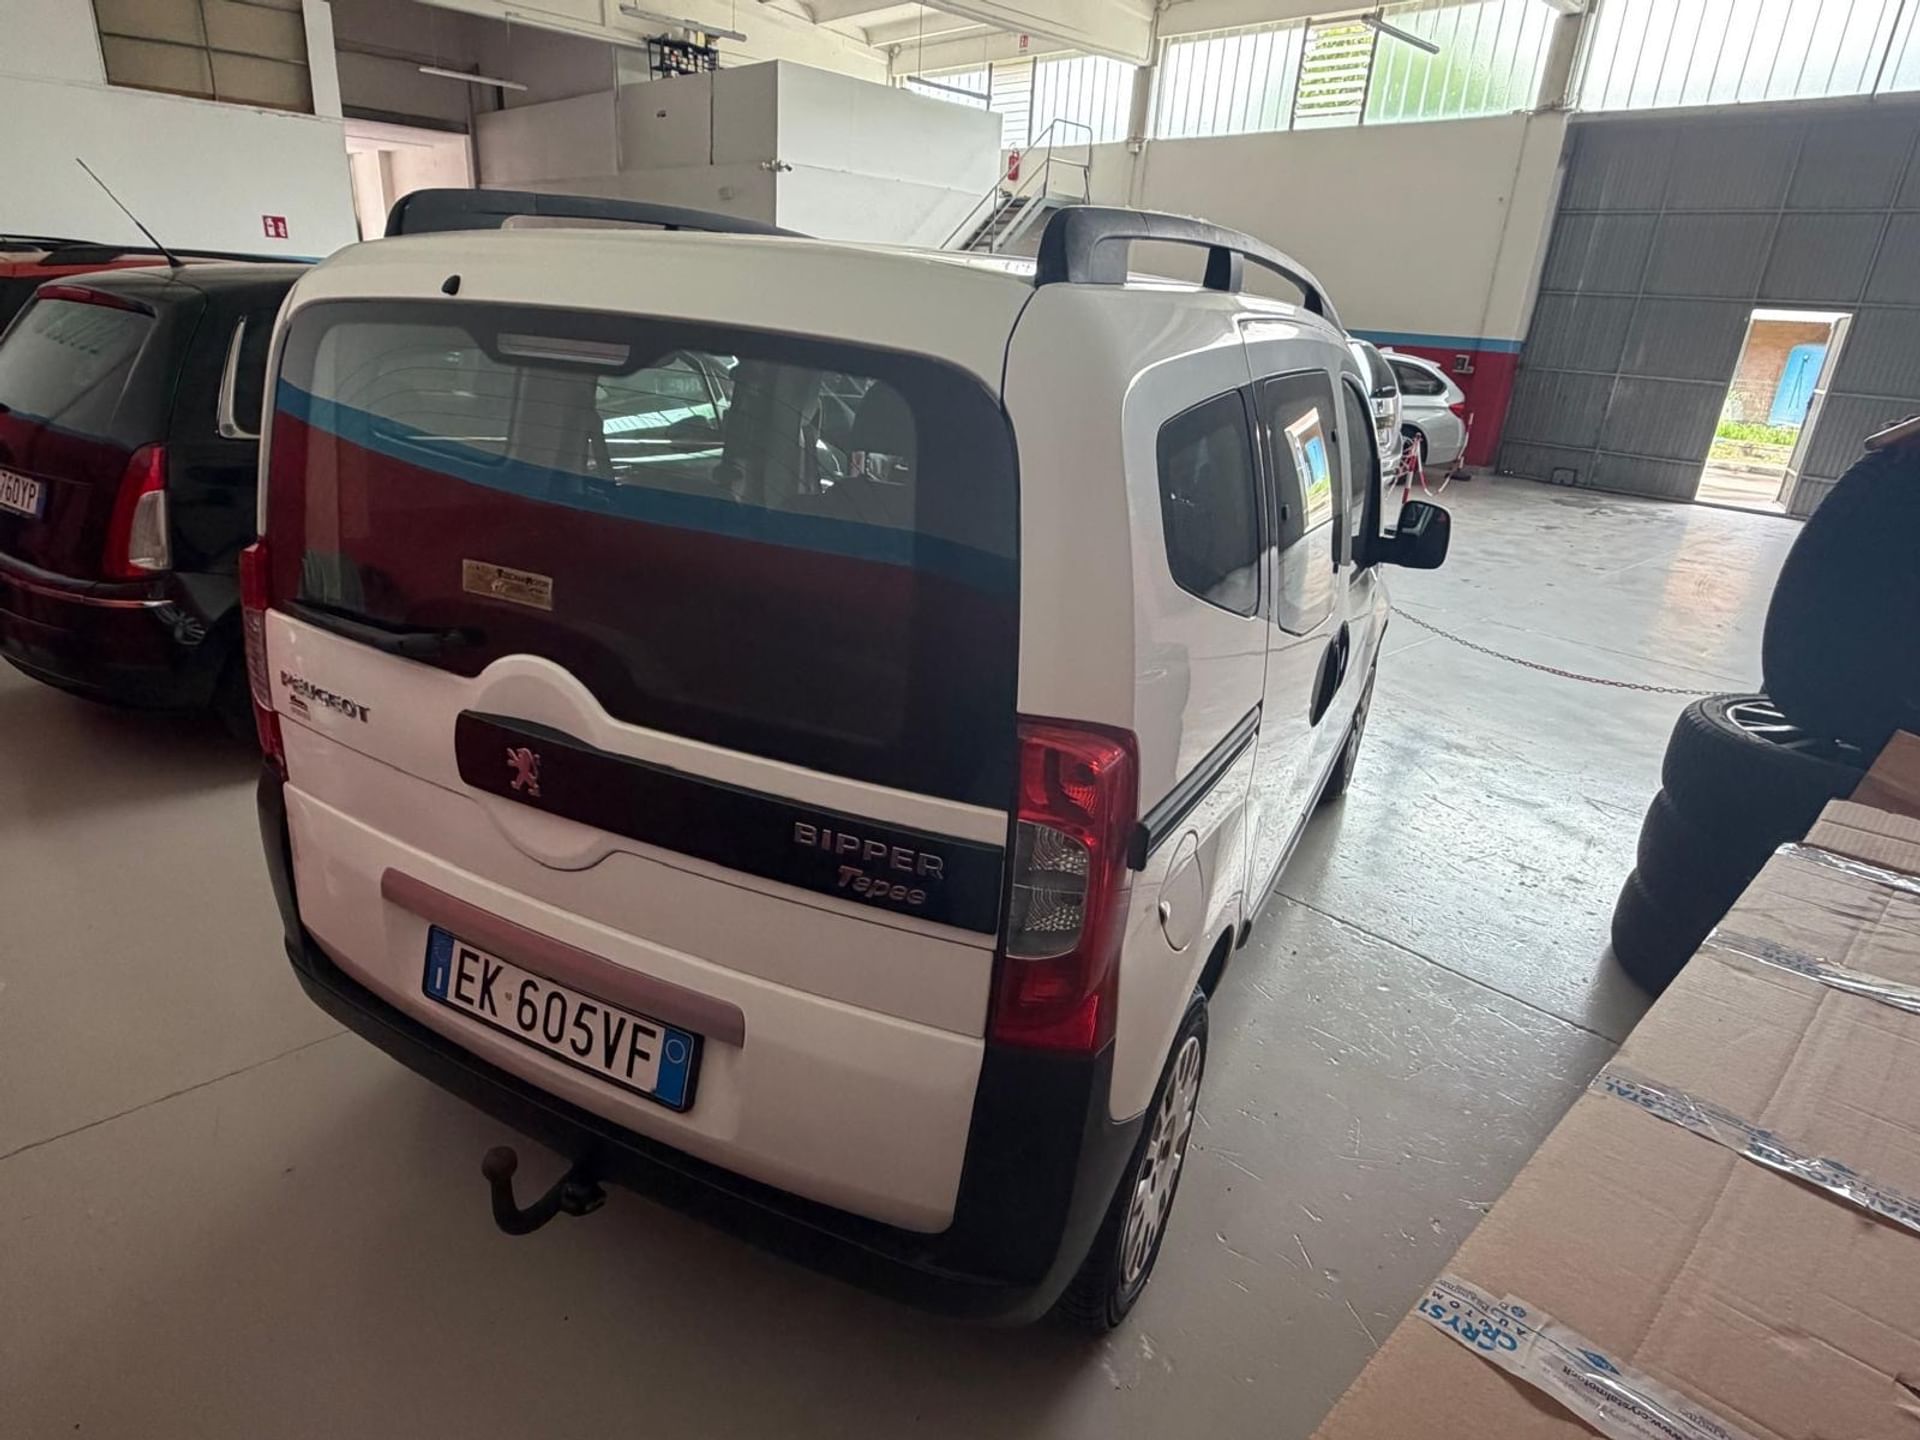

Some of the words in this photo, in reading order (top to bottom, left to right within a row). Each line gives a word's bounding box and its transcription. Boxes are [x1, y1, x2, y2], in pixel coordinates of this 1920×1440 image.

[280, 670, 370, 723] PEUGEOT
[794, 822, 944, 880] BIPPER
[838, 865, 927, 904] Tepee
[454, 948, 504, 1017] EK
[516, 979, 657, 1079] 605VF
